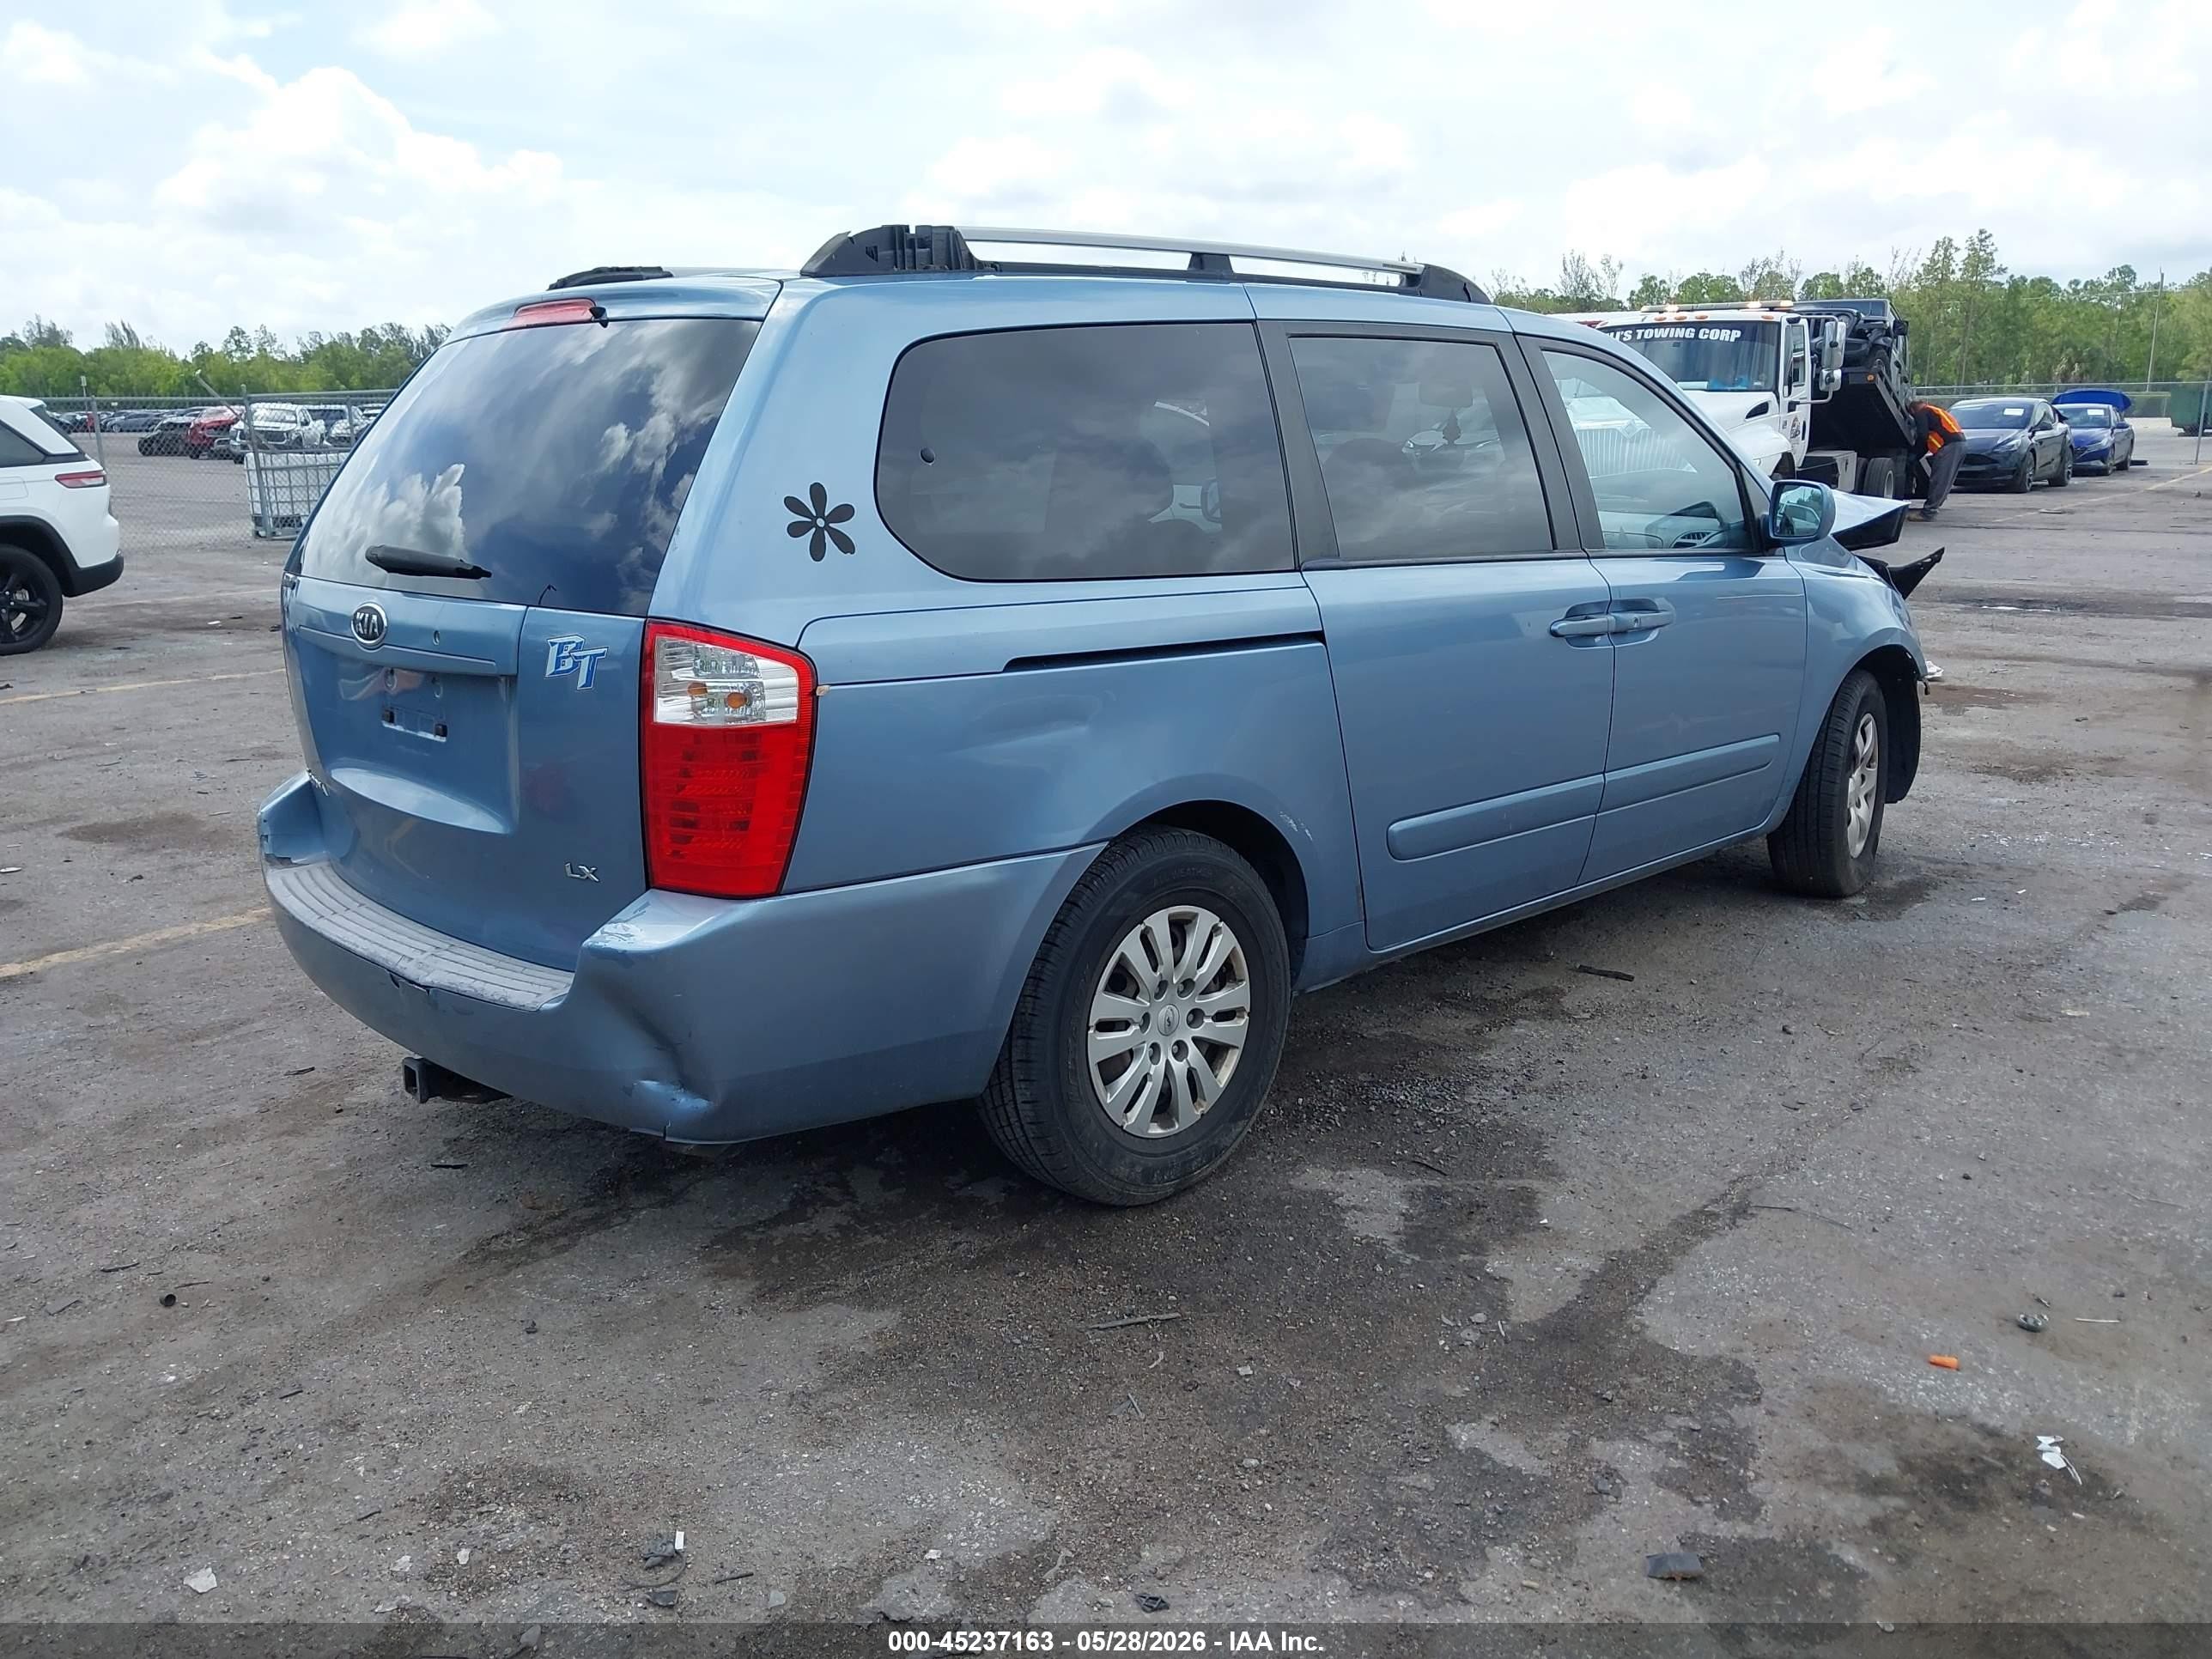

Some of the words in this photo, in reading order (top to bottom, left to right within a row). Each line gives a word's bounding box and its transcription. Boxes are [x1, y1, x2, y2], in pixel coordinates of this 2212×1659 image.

[1636, 327, 1695, 340] TOWING
[1698, 327, 1741, 343] CORP
[354, 611, 380, 636] KIA
[544, 634, 610, 690] BT
[563, 861, 600, 883] LX
